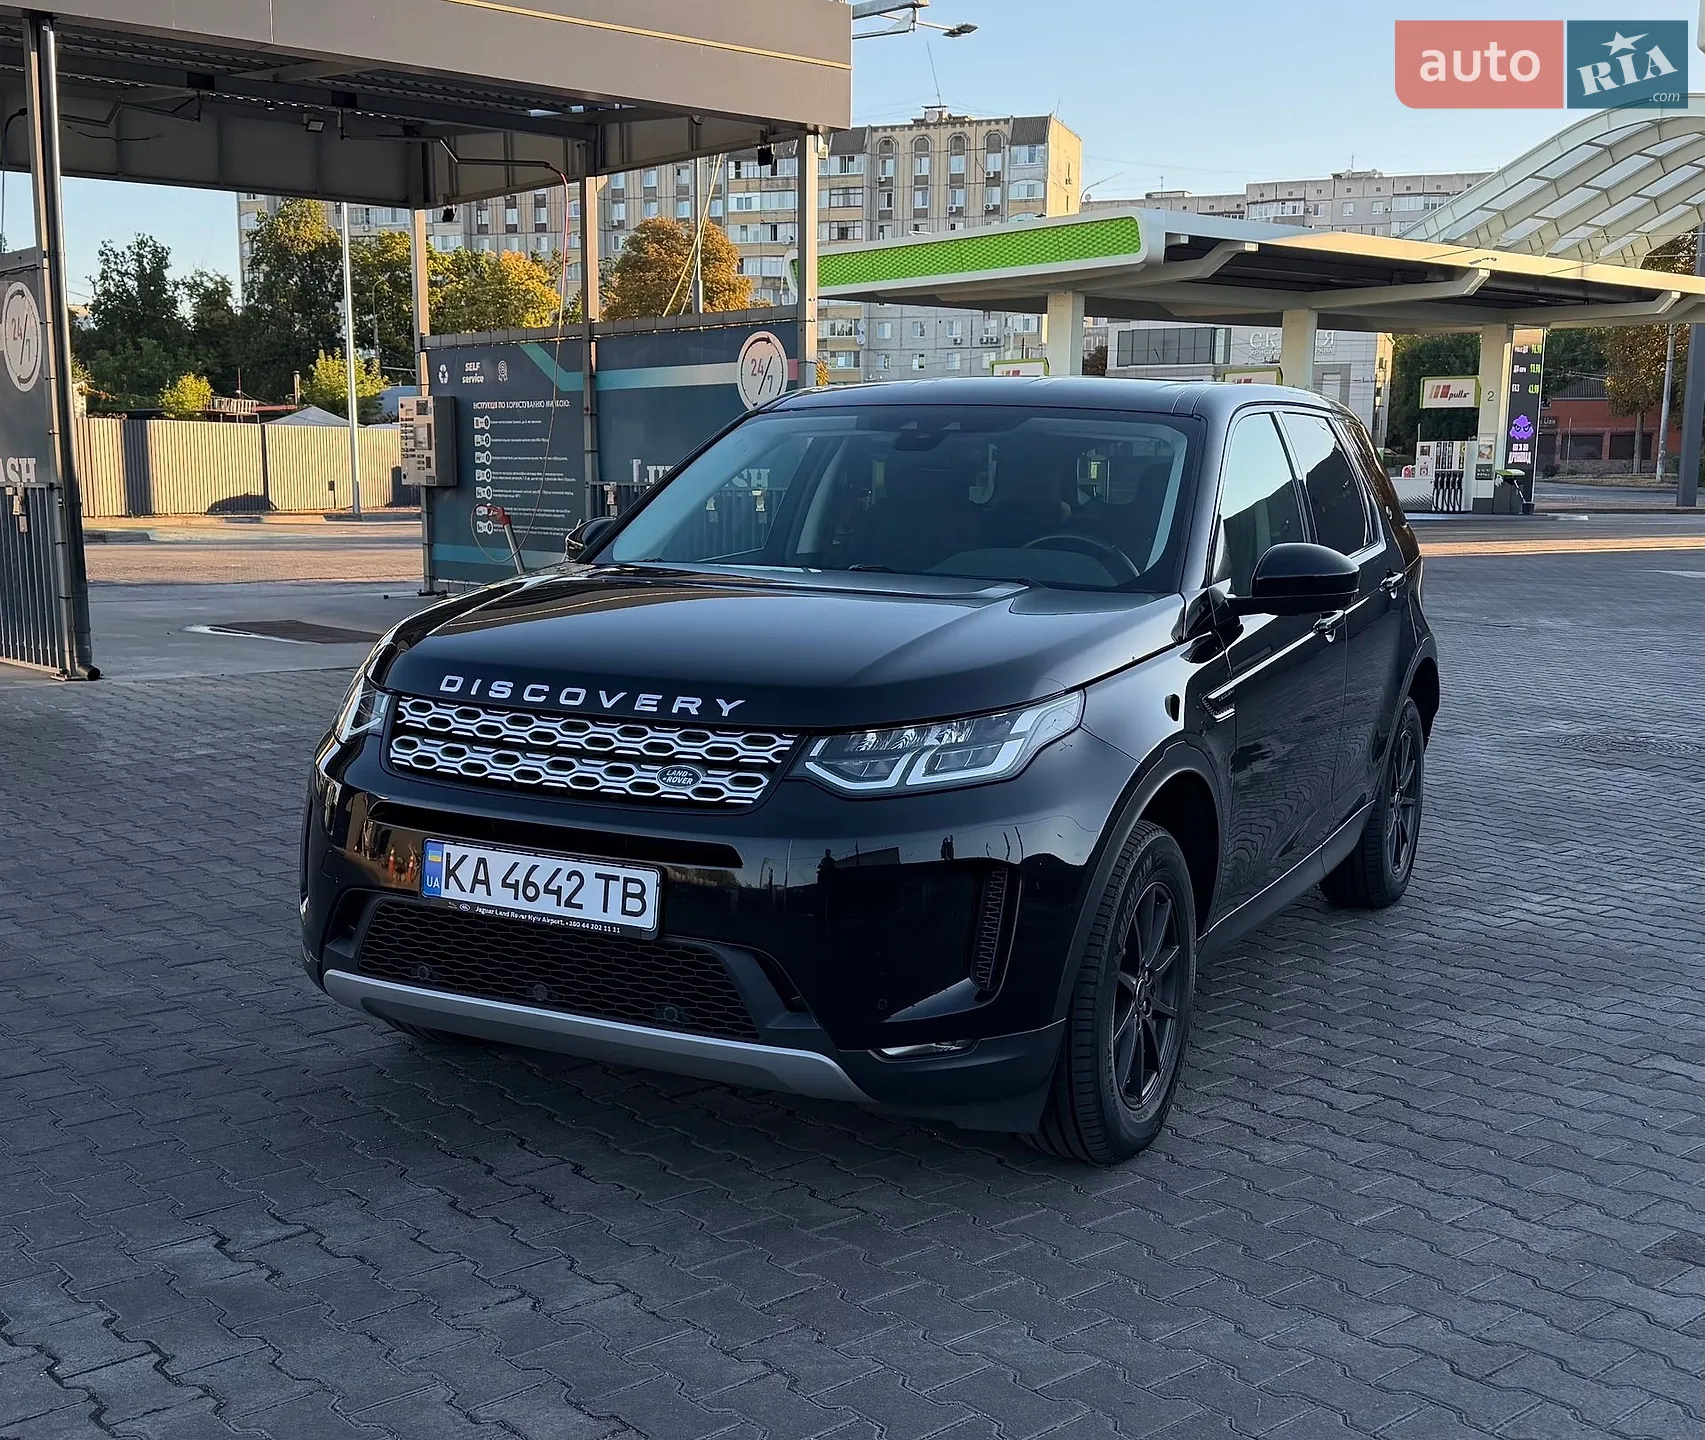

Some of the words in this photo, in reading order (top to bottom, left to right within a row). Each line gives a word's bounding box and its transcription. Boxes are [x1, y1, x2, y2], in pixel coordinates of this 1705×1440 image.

[465, 362, 481, 372] SELF
[751, 356, 774, 395] 24/7
[462, 373, 485, 384] service
[1487, 391, 1495, 401] 2
[440, 675, 746, 717] DISCOVERY
[426, 875, 441, 889] UA
[444, 852, 492, 897] KA
[500, 861, 586, 910] 4642
[594, 872, 648, 918] TB
[475, 906, 494, 916] Jaguar
[495, 909, 510, 918] Land
[510, 911, 527, 920] Rover
[590, 923, 603, 931] 202
